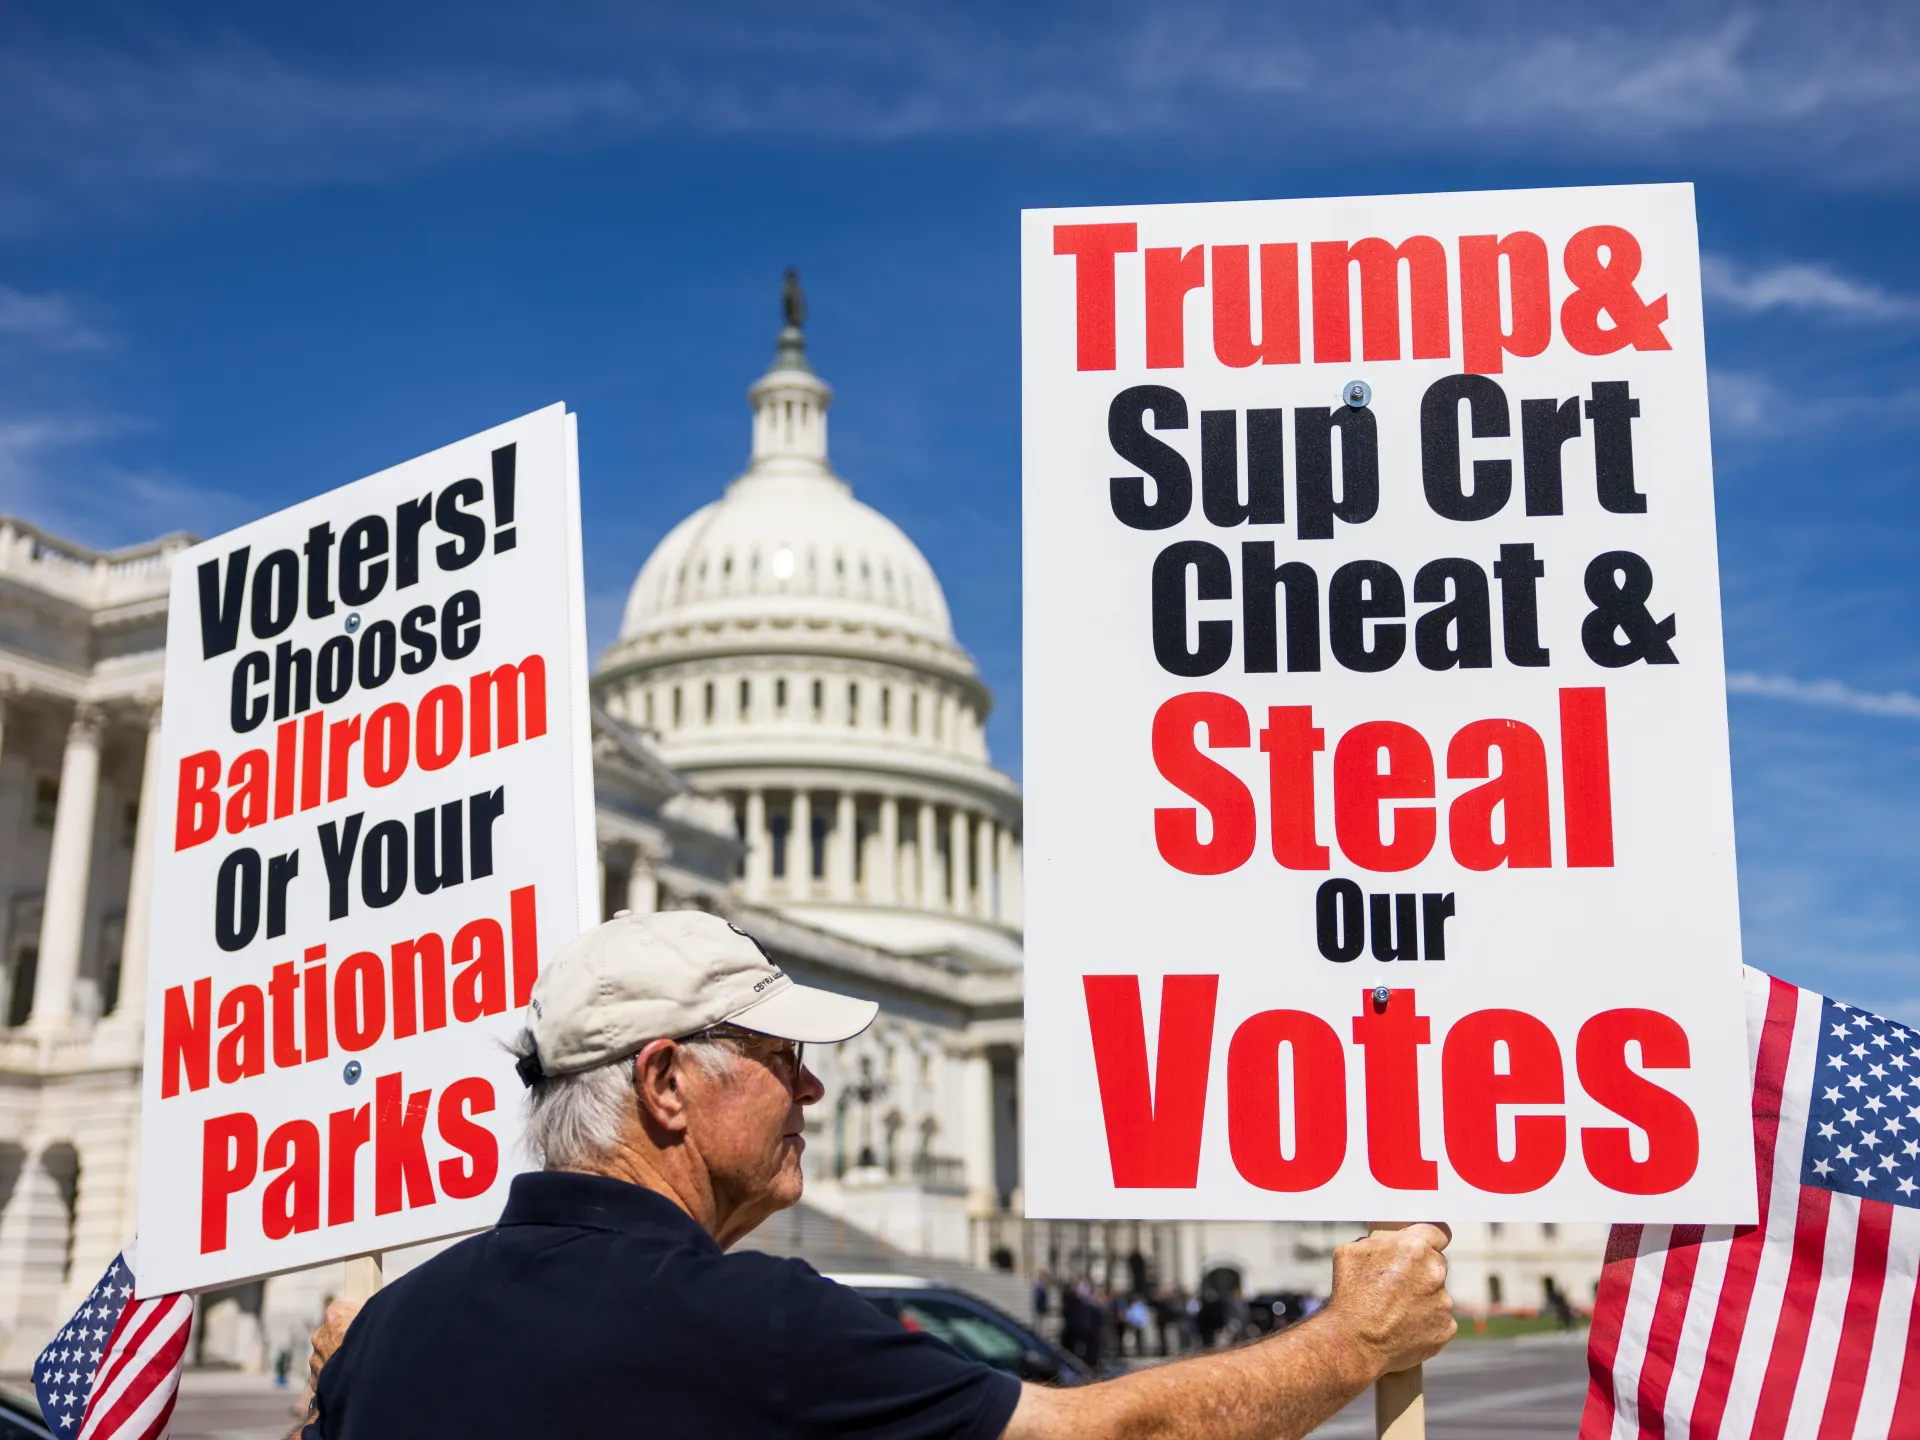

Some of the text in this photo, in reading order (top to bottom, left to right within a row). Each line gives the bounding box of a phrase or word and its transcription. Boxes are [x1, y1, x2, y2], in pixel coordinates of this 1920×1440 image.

[1054, 222, 1672, 375] Trump&
[1108, 373, 1647, 540] Sup Crt
[197, 442, 517, 661] Voters!
[1151, 540, 1680, 678] Cheat &
[230, 589, 481, 734] Choose
[174, 654, 548, 853] Ballroom
[1151, 686, 1615, 876] Steal
[215, 785, 505, 952] Or Your
[1316, 877, 1456, 963] Our
[161, 884, 539, 1100] National
[200, 1071, 500, 1255] Parks
[1082, 974, 1700, 1196] Votes
